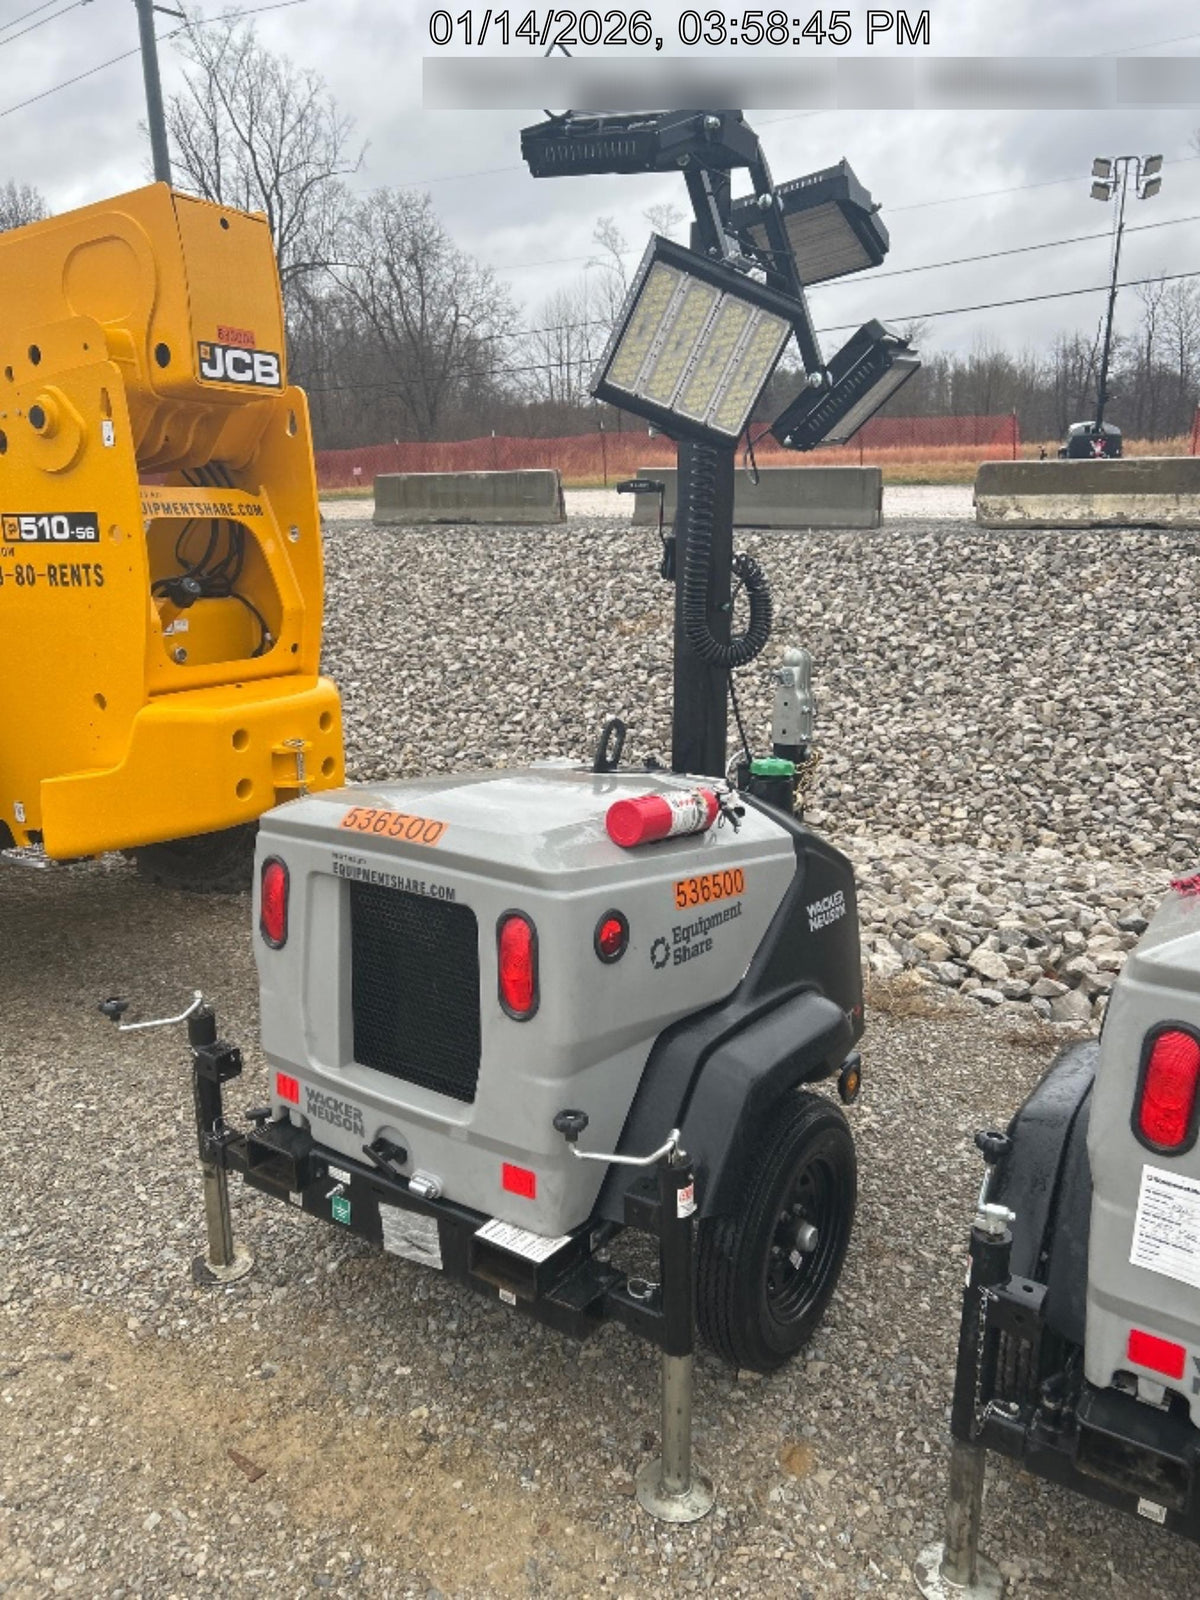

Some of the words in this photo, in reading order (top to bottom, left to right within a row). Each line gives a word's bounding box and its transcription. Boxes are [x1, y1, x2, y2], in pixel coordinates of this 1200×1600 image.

[202, 347, 280, 385] JCB
[342, 808, 444, 844] 536500
[332, 861, 456, 901] EQUIPMENTSHARE.COM
[676, 868, 744, 908] 536500
[671, 901, 743, 945] Equipment
[673, 937, 714, 966] Share
[305, 1086, 363, 1122] WACKER
[307, 1100, 365, 1138] NEUSON
